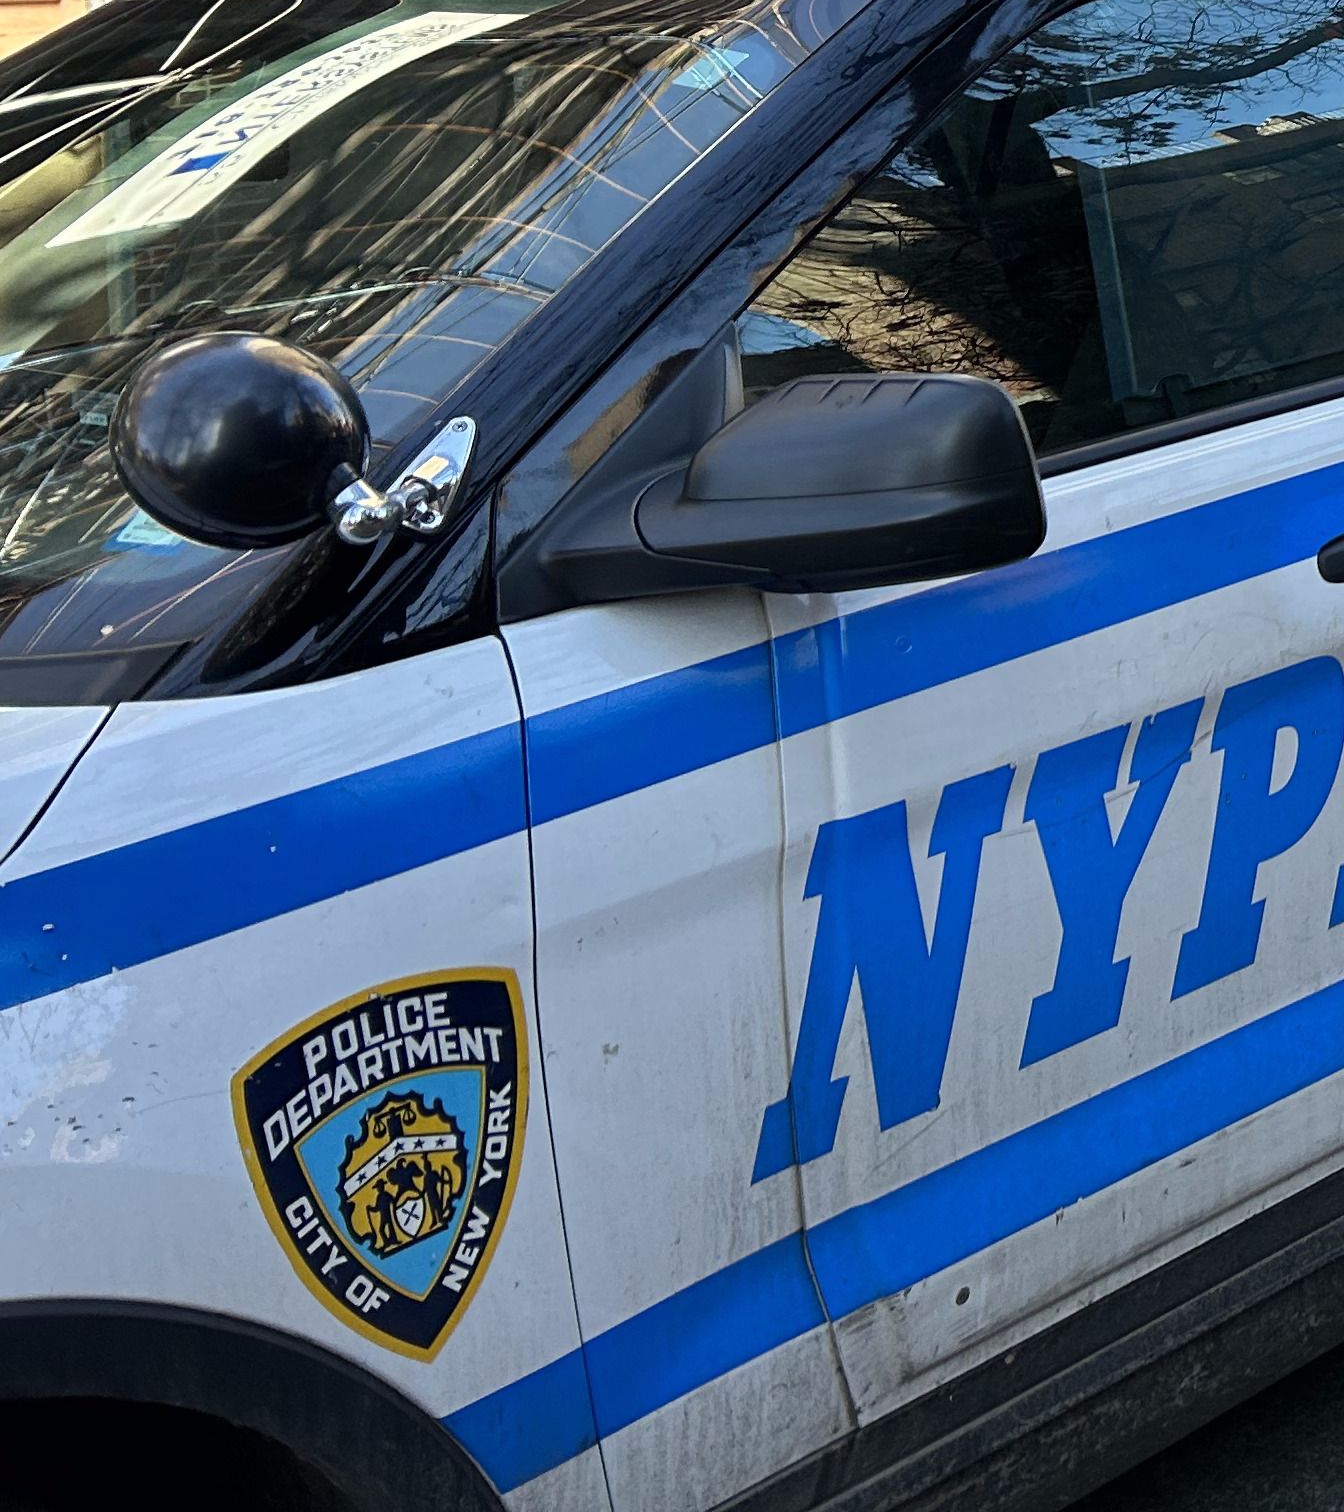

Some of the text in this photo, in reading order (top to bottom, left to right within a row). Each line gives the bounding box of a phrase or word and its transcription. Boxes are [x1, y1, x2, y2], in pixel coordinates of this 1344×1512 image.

[262, 1025, 503, 1163] DEPARTMENT
[302, 990, 452, 1079] POLICE
[285, 1081, 512, 1314] CITY OF NEW YORK
